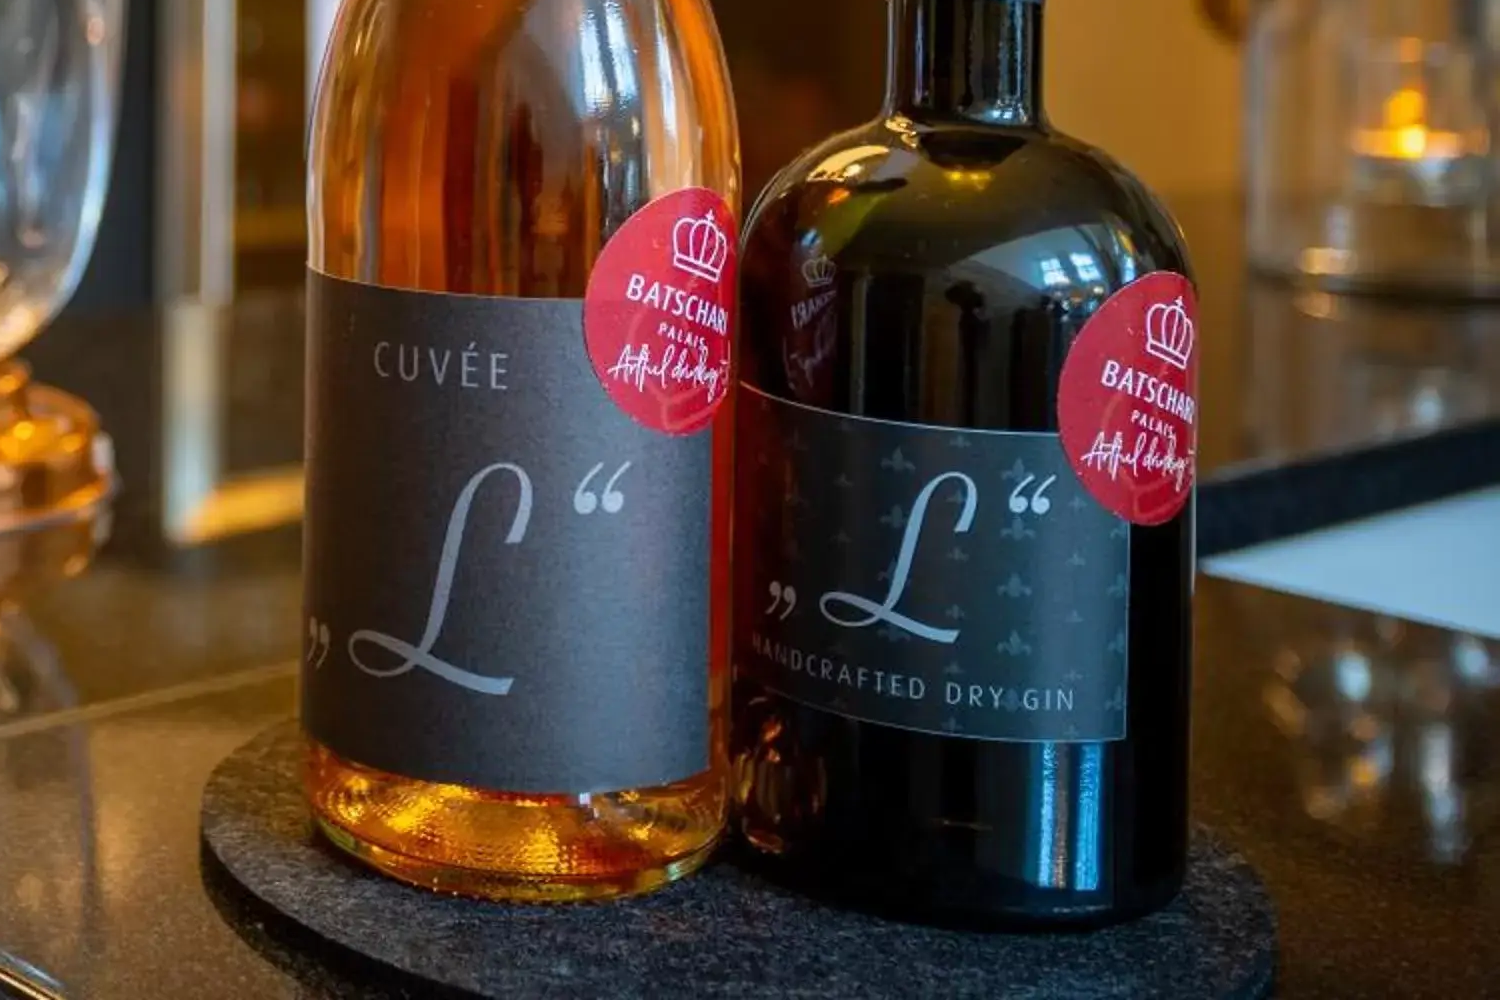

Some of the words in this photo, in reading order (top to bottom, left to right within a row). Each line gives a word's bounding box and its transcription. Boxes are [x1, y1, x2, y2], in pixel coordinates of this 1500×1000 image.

[656, 321, 707, 350] PALAIS
[373, 341, 510, 391] CUVÉE
[1129, 409, 1177, 438] PALAIS
[752, 631, 926, 700] HANDCRAFTED
[945, 682, 1005, 706] DRY
[1022, 689, 1075, 712] GIN
